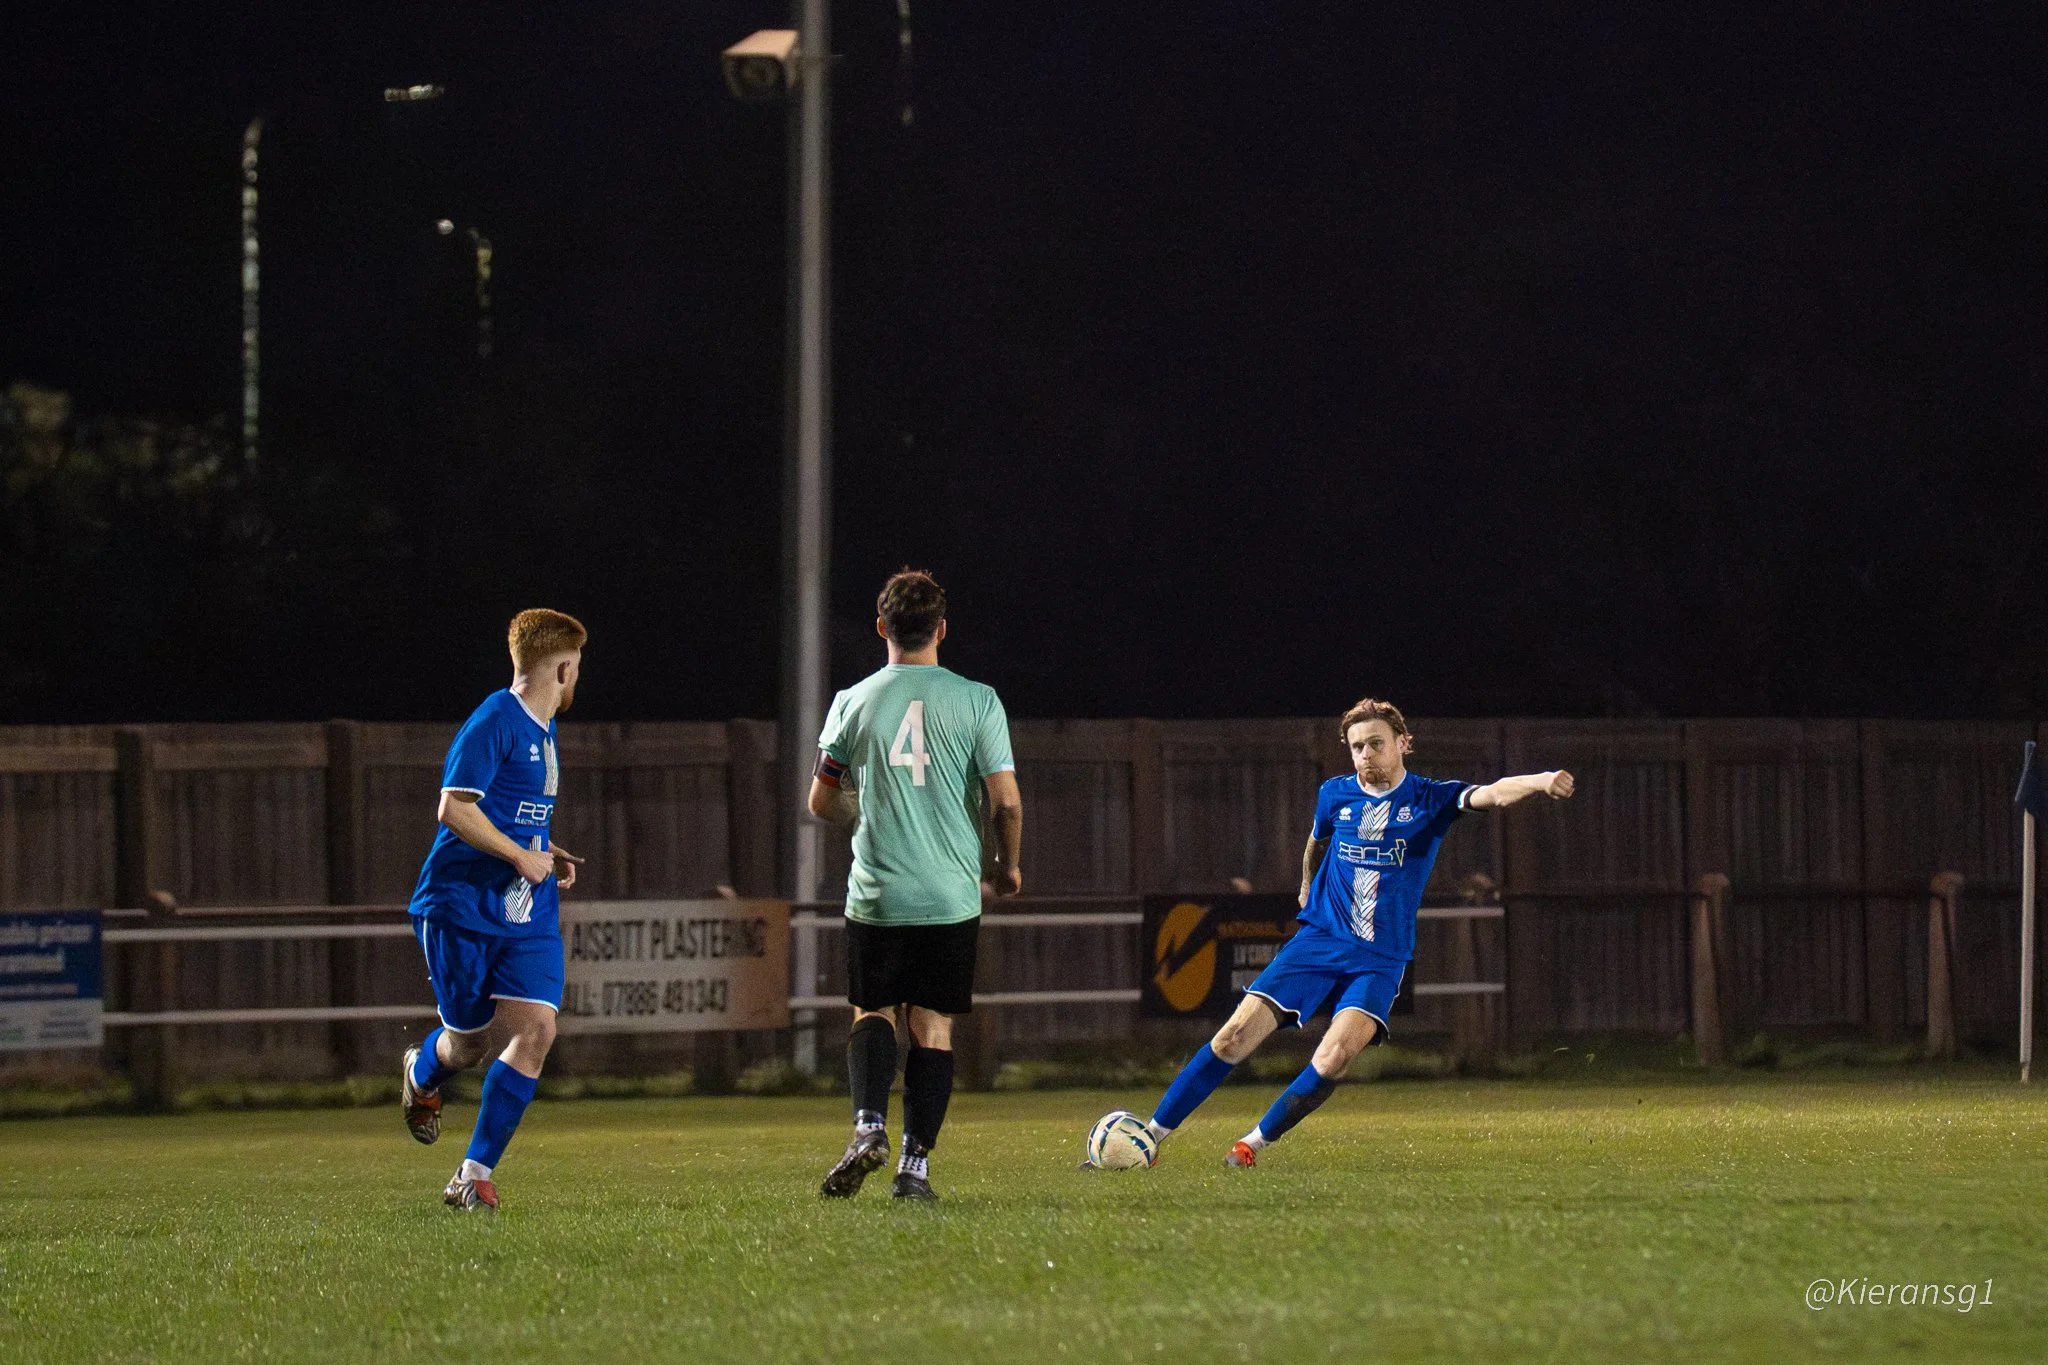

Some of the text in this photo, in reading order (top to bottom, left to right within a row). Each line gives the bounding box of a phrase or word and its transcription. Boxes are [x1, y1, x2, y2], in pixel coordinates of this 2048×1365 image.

[888, 700, 932, 786] 4
[651, 917, 766, 959] PLASTERING
[559, 980, 598, 1017] ALL:
